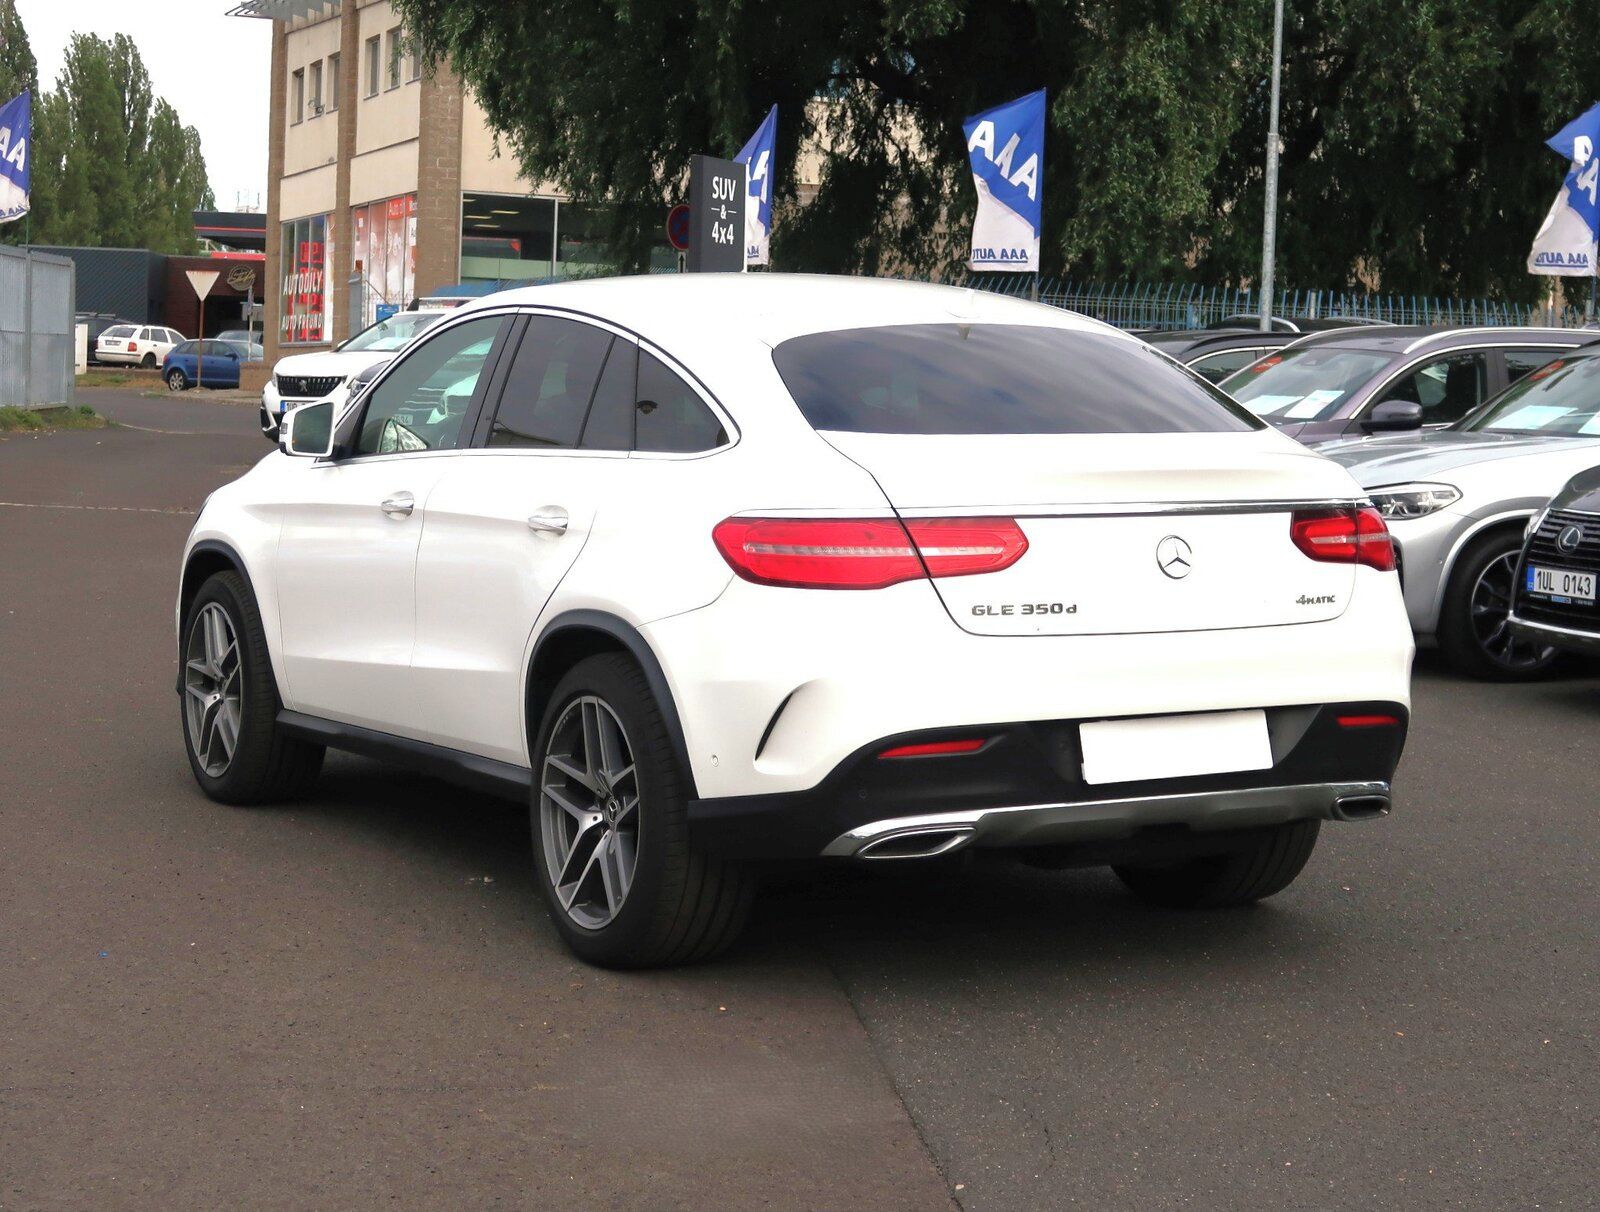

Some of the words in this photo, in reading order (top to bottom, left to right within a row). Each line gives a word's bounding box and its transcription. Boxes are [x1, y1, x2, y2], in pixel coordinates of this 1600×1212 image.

[712, 176, 736, 201] SUV
[720, 204, 727, 219] &
[712, 221, 734, 245] 4x4
[1537, 569, 1555, 592] 1UL
[1563, 574, 1591, 596] 0143
[971, 604, 1015, 616] GLE
